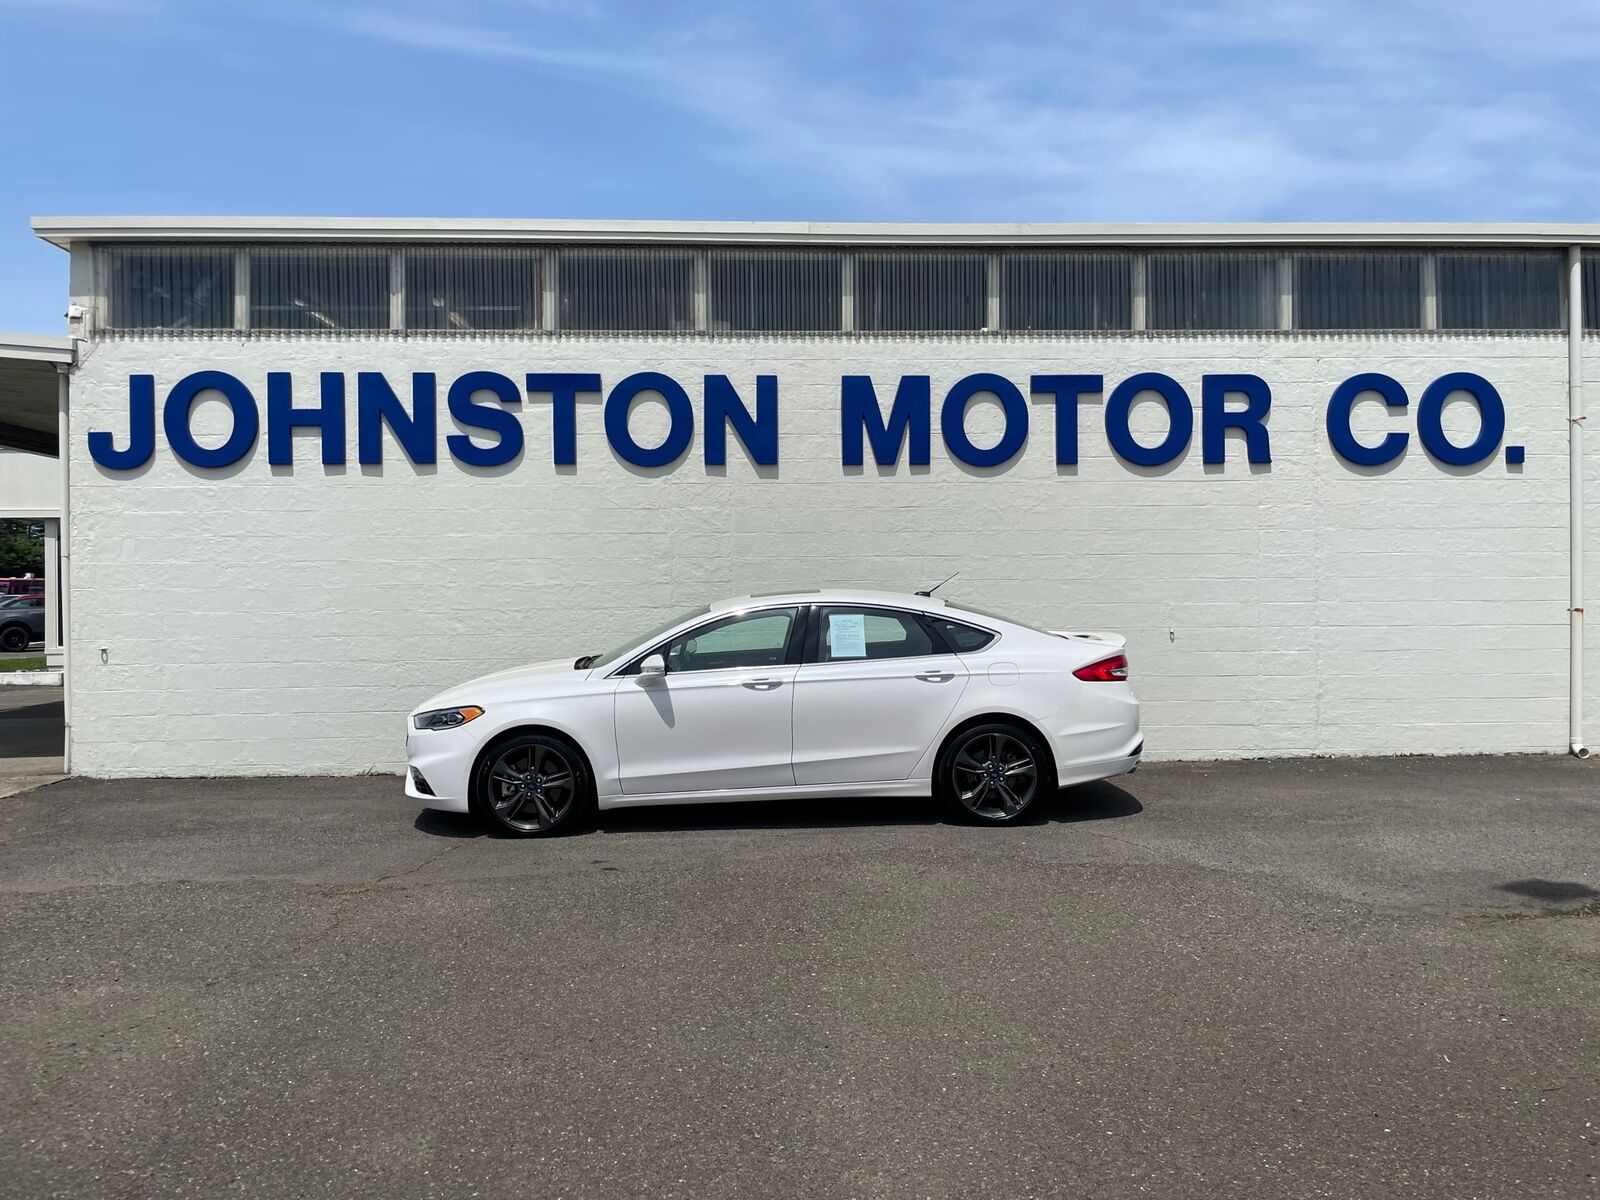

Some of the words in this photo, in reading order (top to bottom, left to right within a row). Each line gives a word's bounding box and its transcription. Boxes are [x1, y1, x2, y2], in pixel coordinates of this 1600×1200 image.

[88, 370, 778, 471] JOHNSTON
[841, 372, 1272, 468] MOTOR
[1327, 372, 1525, 467] CO.
